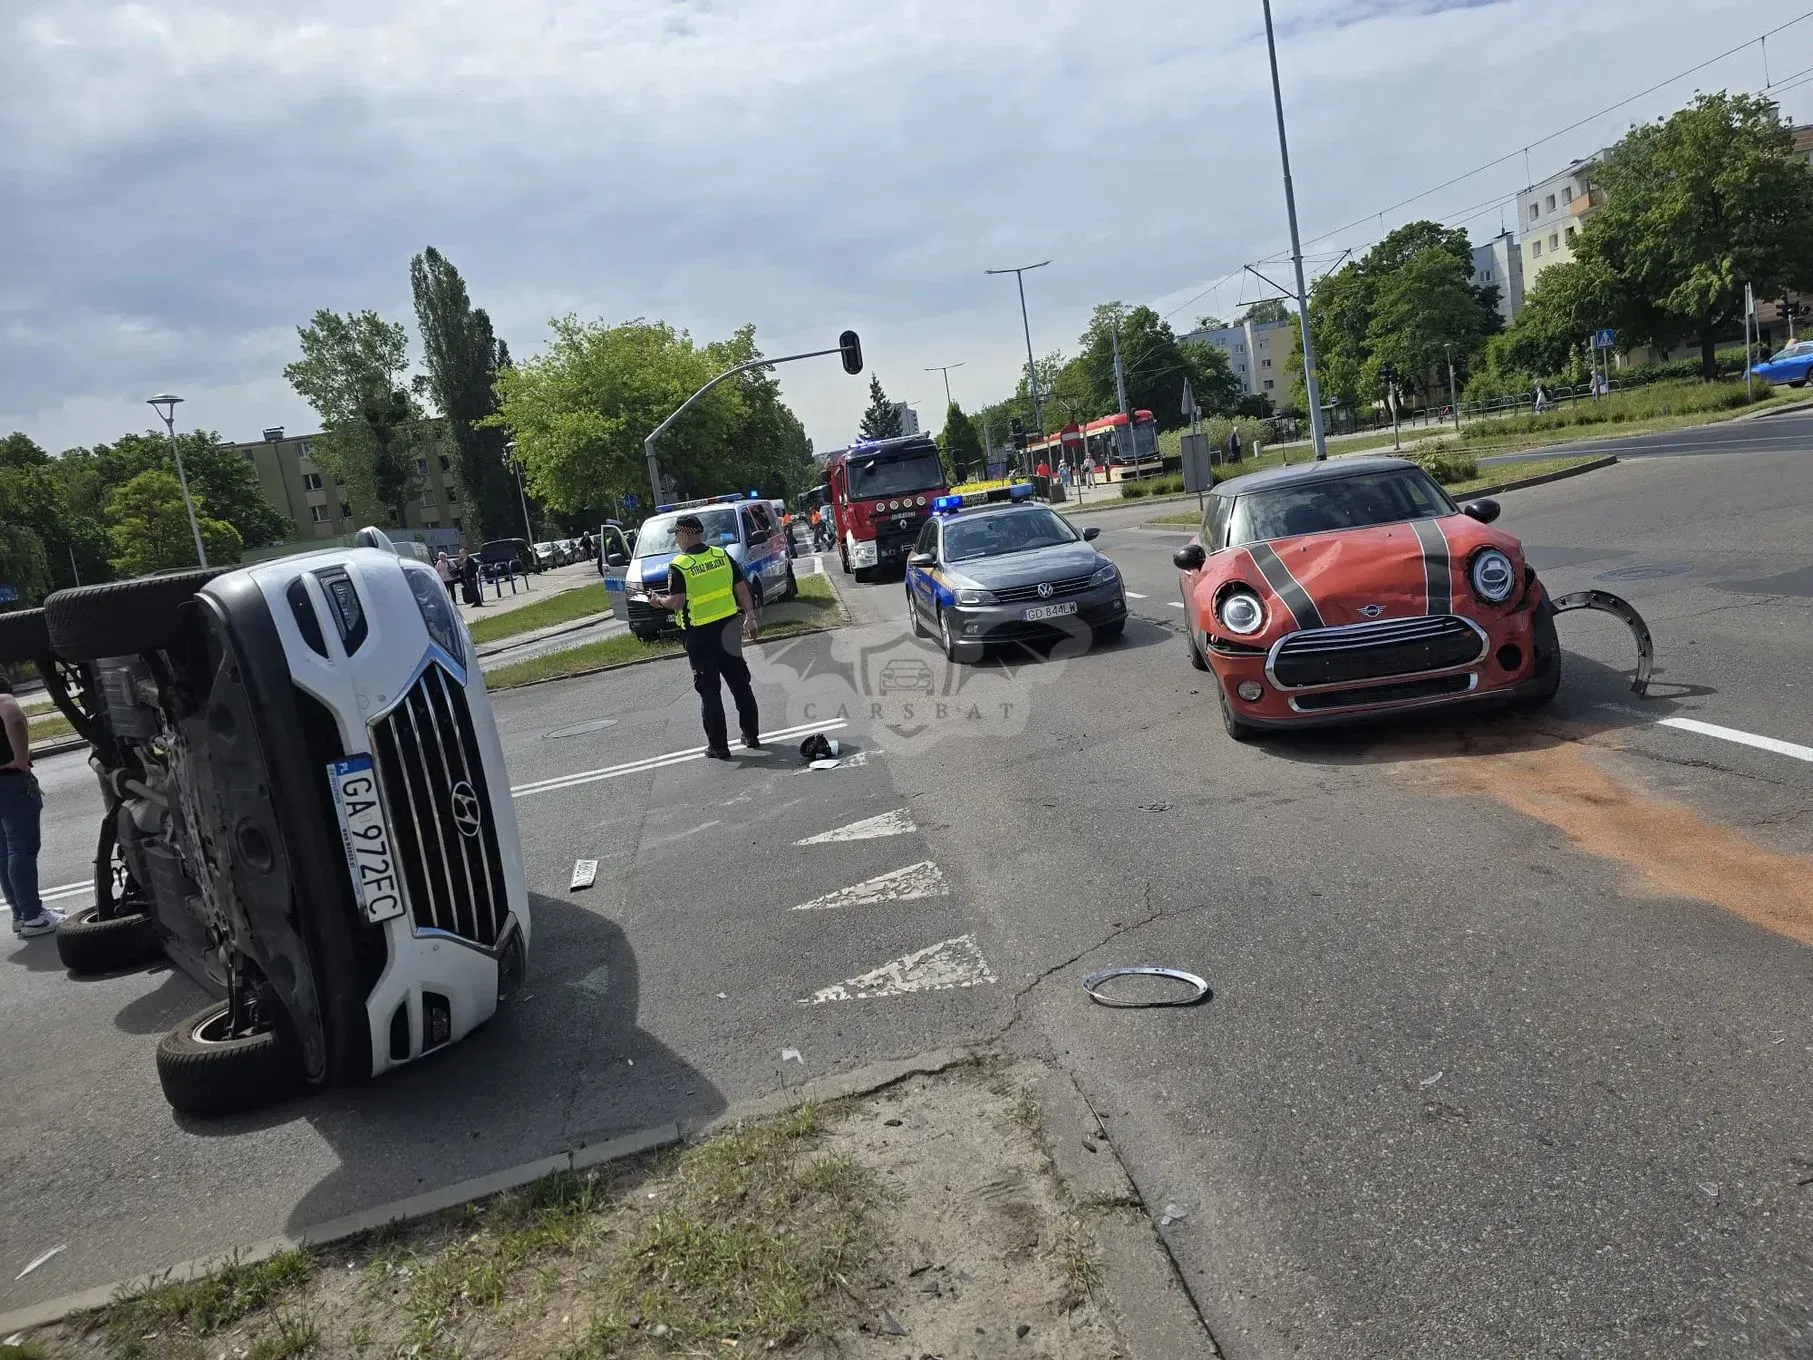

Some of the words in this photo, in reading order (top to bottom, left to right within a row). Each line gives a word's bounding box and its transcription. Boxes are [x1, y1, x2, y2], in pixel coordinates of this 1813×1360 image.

[1028, 608, 1043, 620] GD
[339, 762, 349, 774] PL
[342, 777, 376, 818] GA
[352, 825, 398, 914] 972FC
